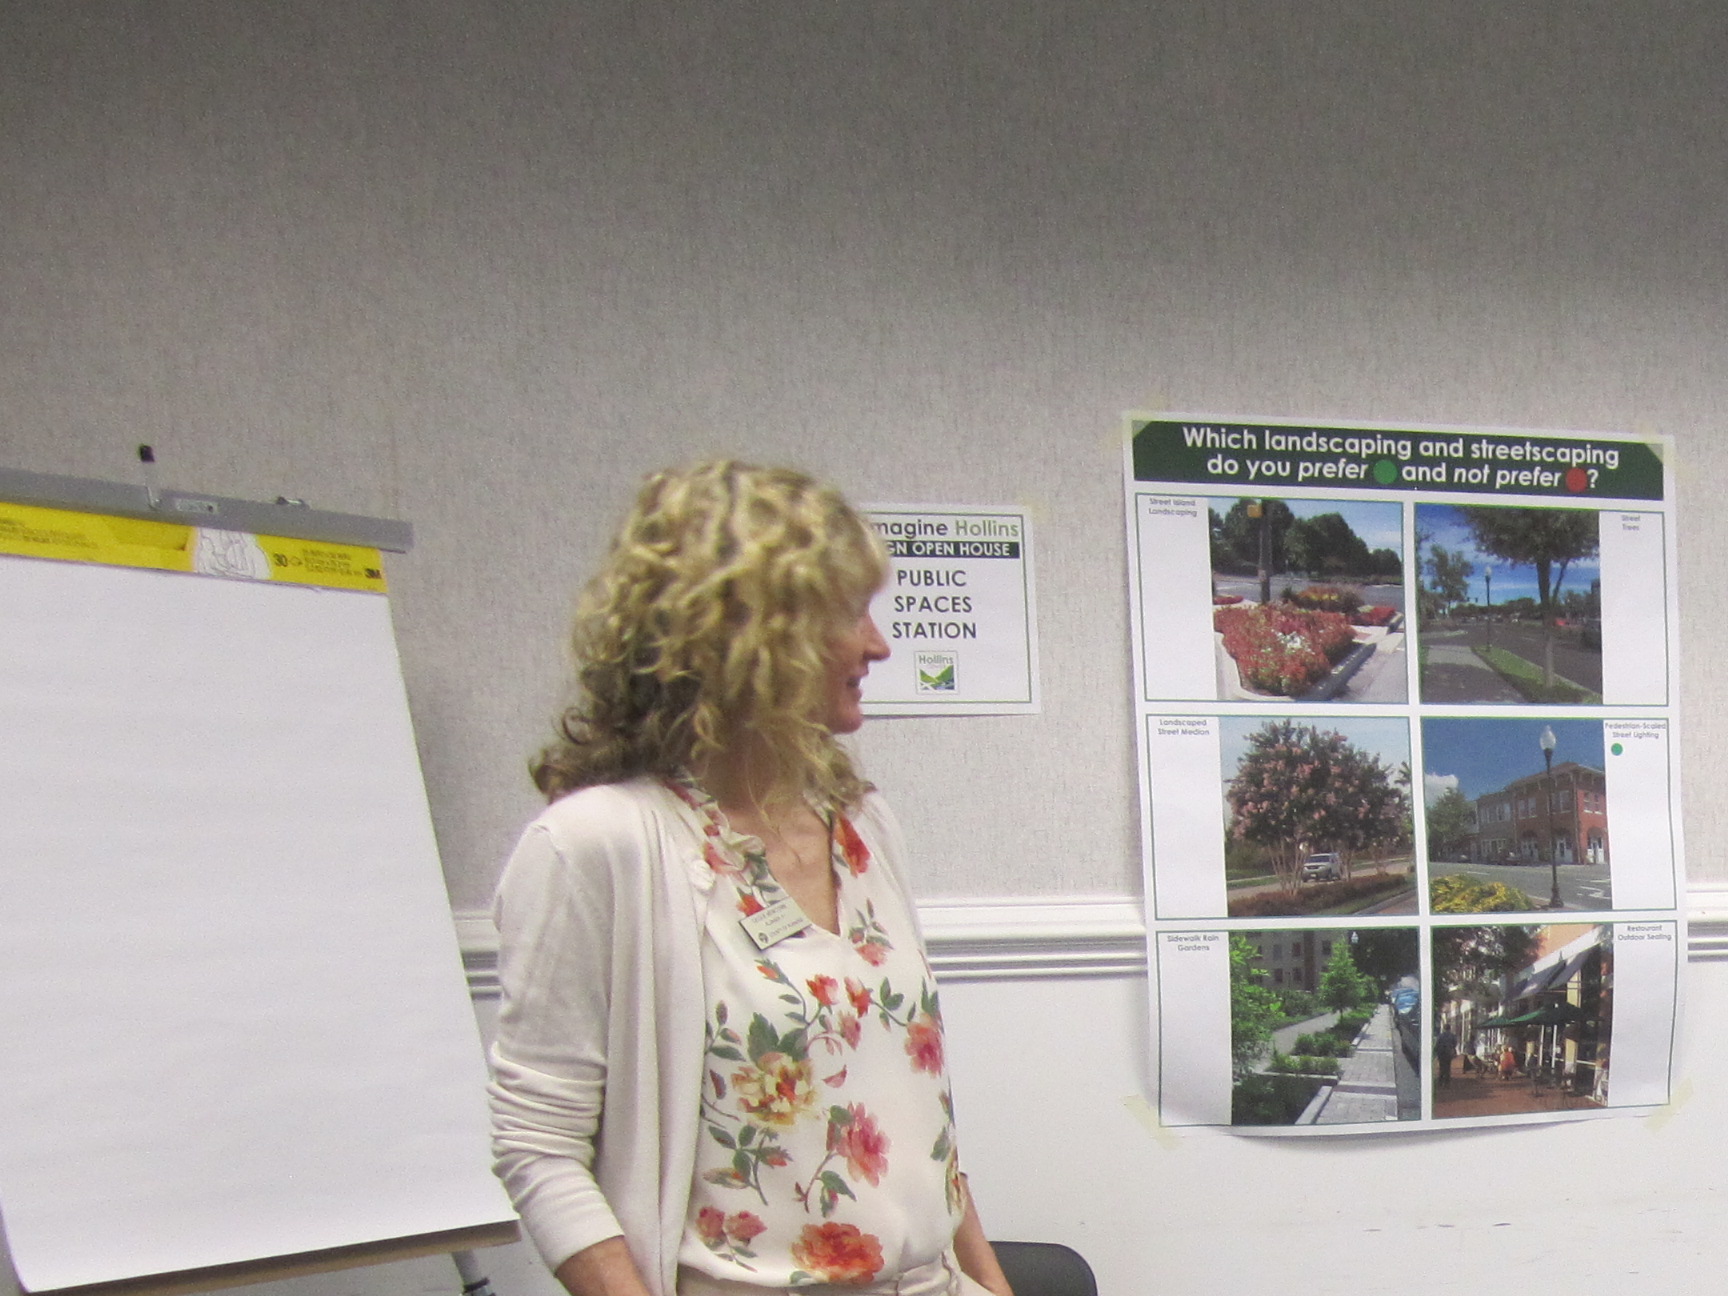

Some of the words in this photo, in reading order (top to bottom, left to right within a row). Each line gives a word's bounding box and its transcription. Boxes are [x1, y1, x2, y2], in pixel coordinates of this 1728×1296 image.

[1183, 427, 1257, 449] Which
[1265, 429, 1411, 460] landscaping
[1419, 438, 1463, 457] and
[1471, 439, 1619, 468] streetscaping
[1207, 453, 1239, 474] do
[1246, 459, 1290, 480] you
[1298, 458, 1369, 482] prefer
[1402, 462, 1447, 483] and
[1453, 466, 1490, 484] not
[1495, 466, 1561, 489] prefer
[1586, 468, 1599, 489] ?
[871, 519, 948, 539] magine
[955, 519, 1019, 537] Hollins
[912, 541, 955, 556] OPEN
[959, 542, 1010, 556] HOUSE
[897, 569, 967, 587] PUBLIC
[894, 596, 972, 613] SPACES
[892, 622, 977, 639] STATION
[919, 654, 954, 664] Hollins
[1160, 719, 1207, 727] Landscaped
